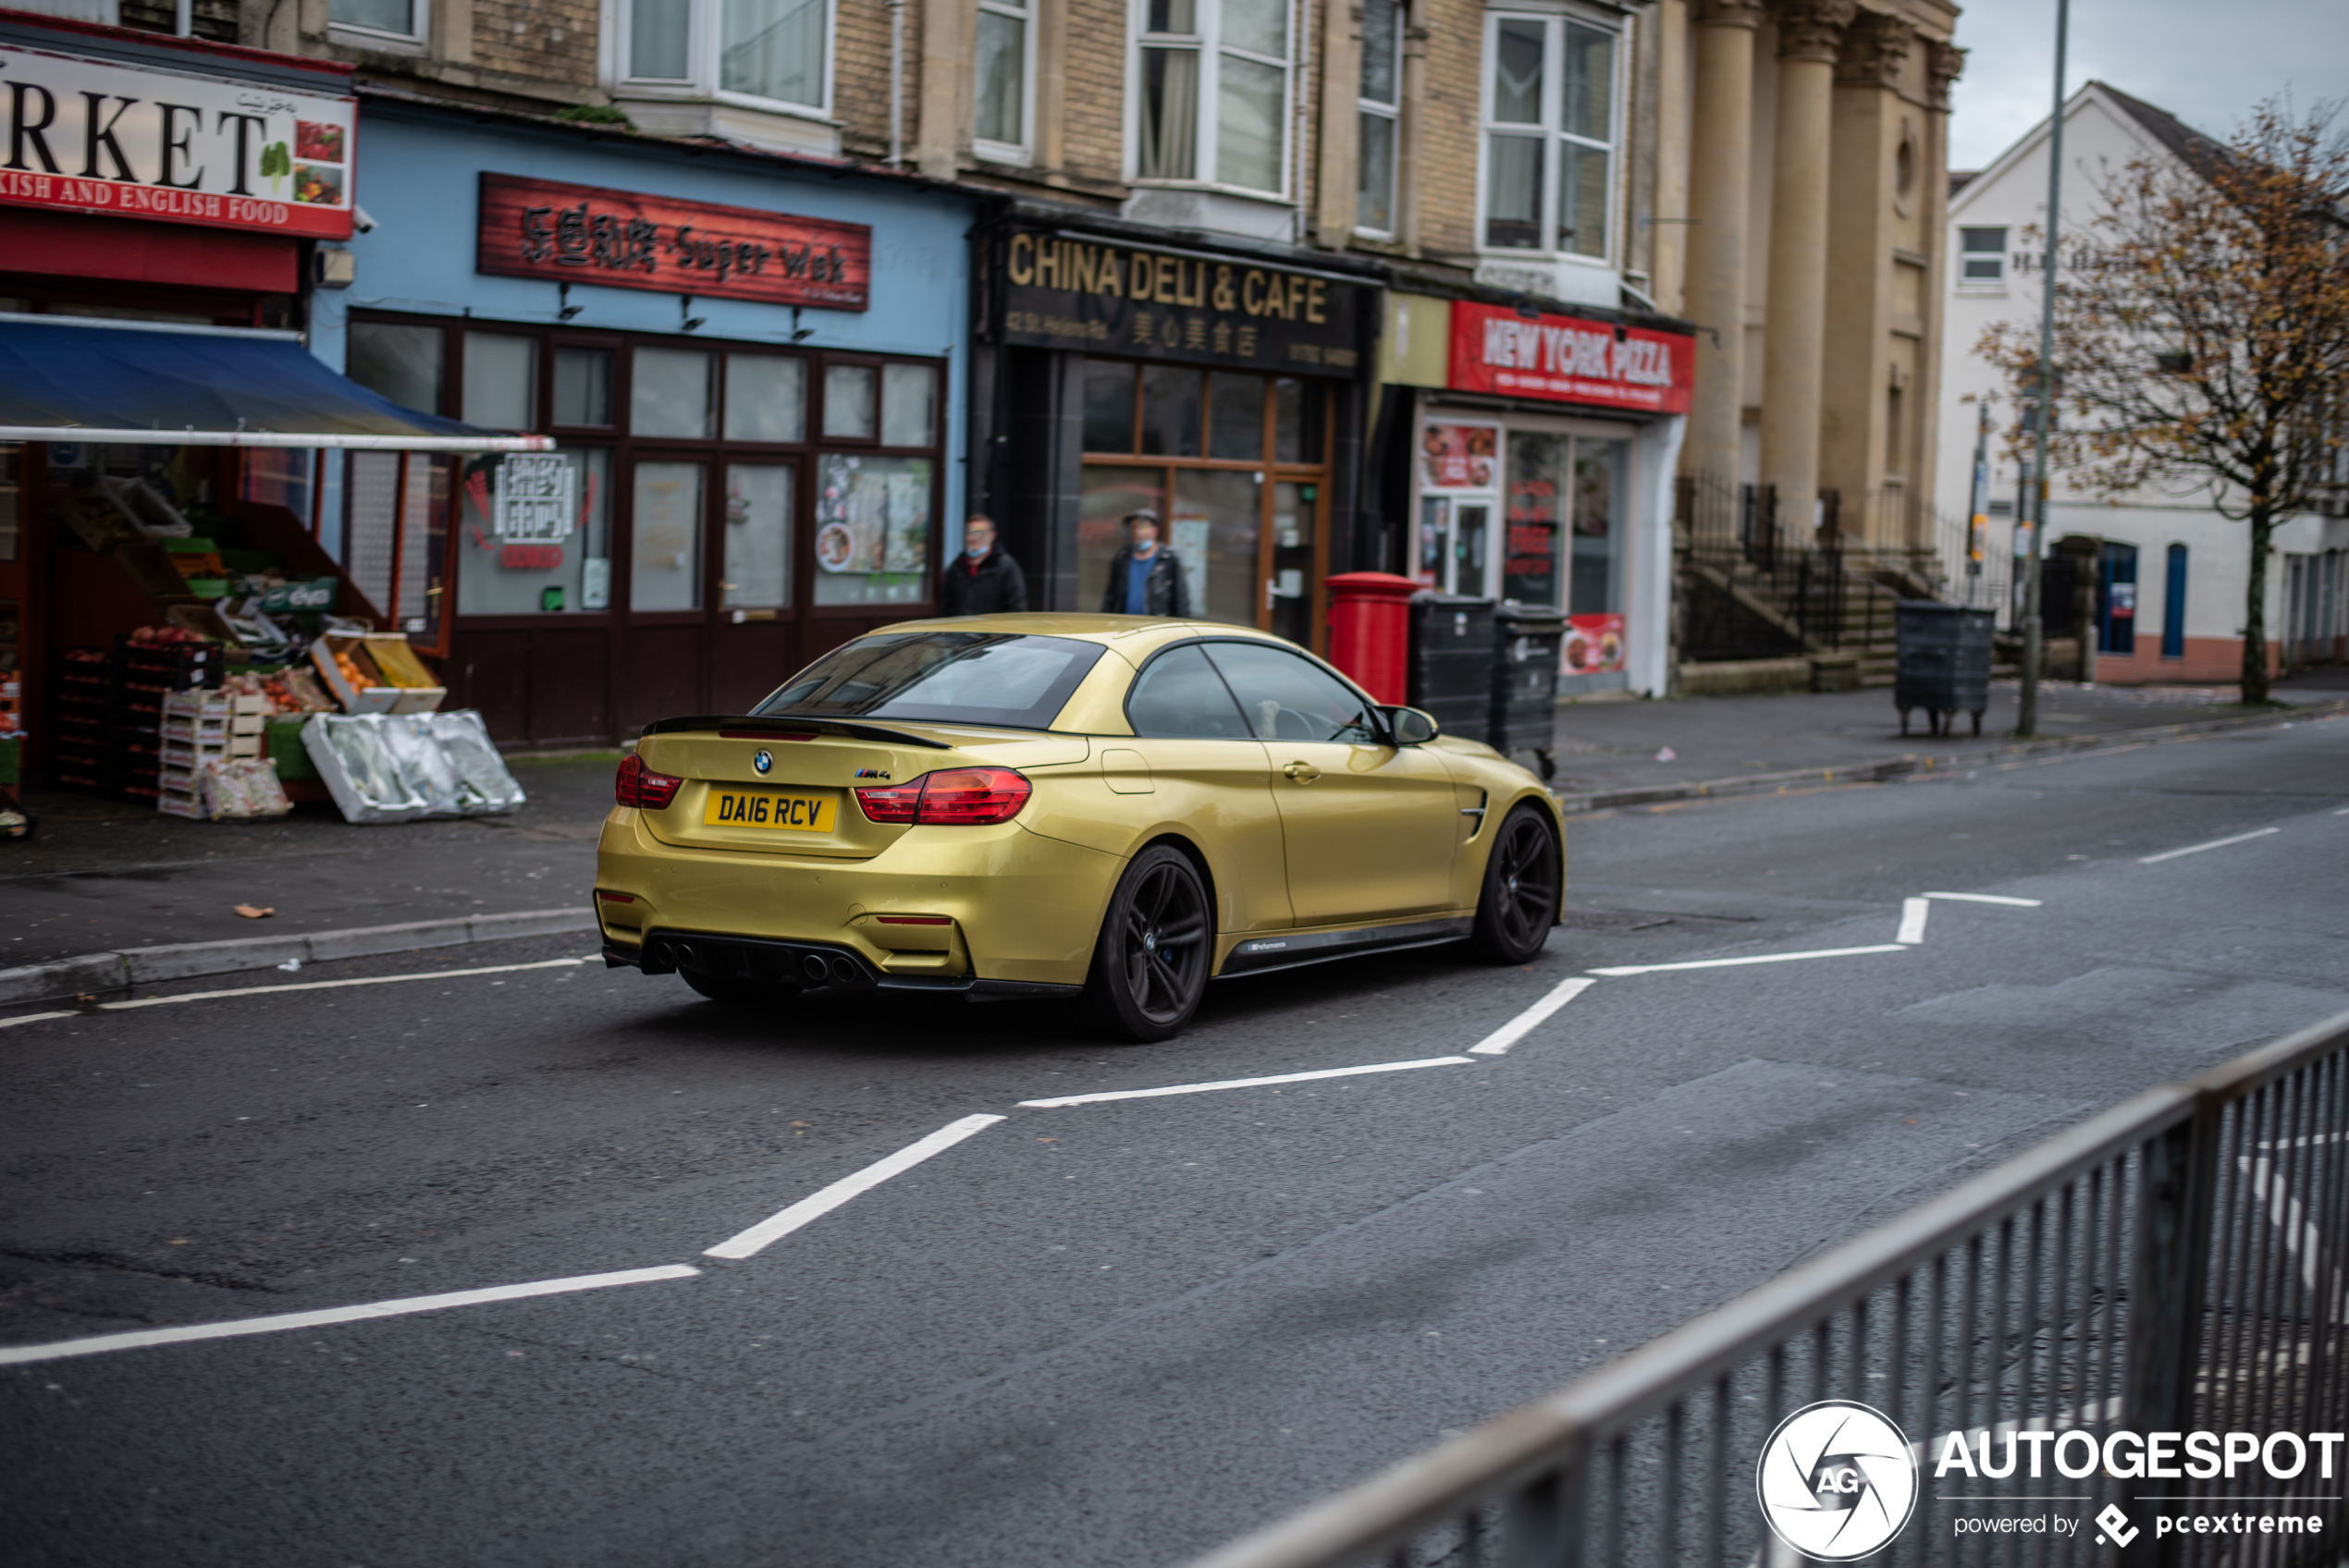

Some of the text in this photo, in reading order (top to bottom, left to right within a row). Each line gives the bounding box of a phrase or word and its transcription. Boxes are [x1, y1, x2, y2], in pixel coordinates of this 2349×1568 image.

[2, 80, 267, 197] RKET
[59, 180, 112, 205] AND
[119, 186, 221, 217] ENGLISH
[228, 198, 289, 225] FOOD
[676, 224, 847, 285] Super Wok
[1008, 233, 1327, 325] CHINA DELI & CAFE
[1483, 318, 1672, 386] NEW YORK PIZZA
[860, 768, 891, 780] M4
[718, 794, 822, 827] DA16 RCV
